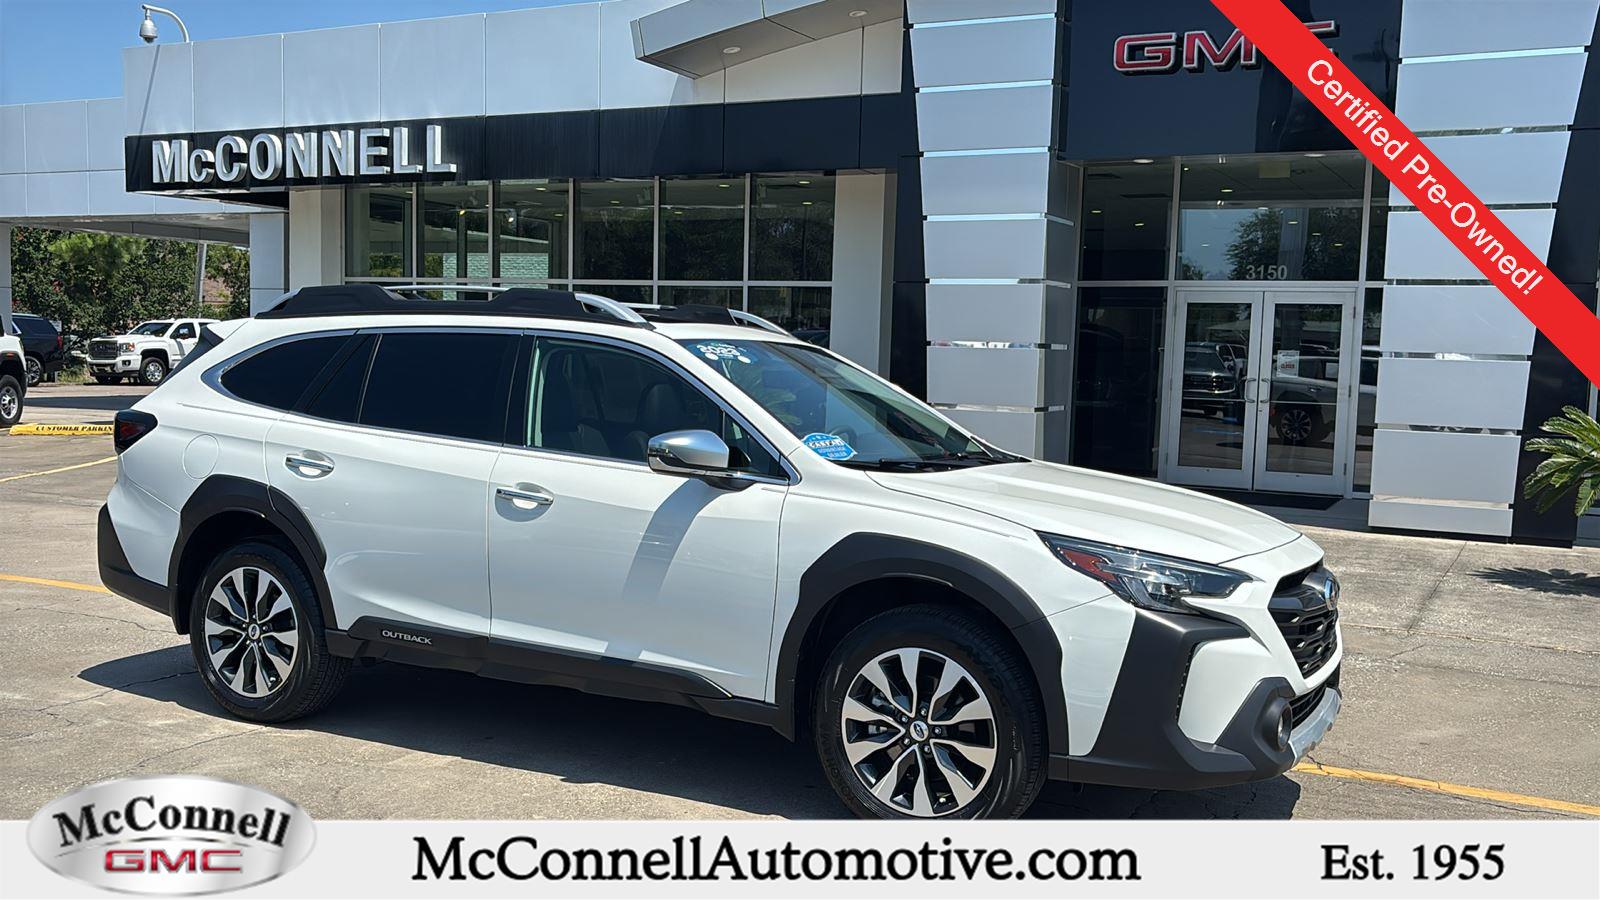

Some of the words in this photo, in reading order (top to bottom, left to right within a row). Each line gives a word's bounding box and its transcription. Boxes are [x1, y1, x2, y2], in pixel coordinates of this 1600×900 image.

[152, 124, 458, 184] McCONNELL
[1246, 264, 1288, 280] 3150
[381, 629, 432, 645] OUTBACK
